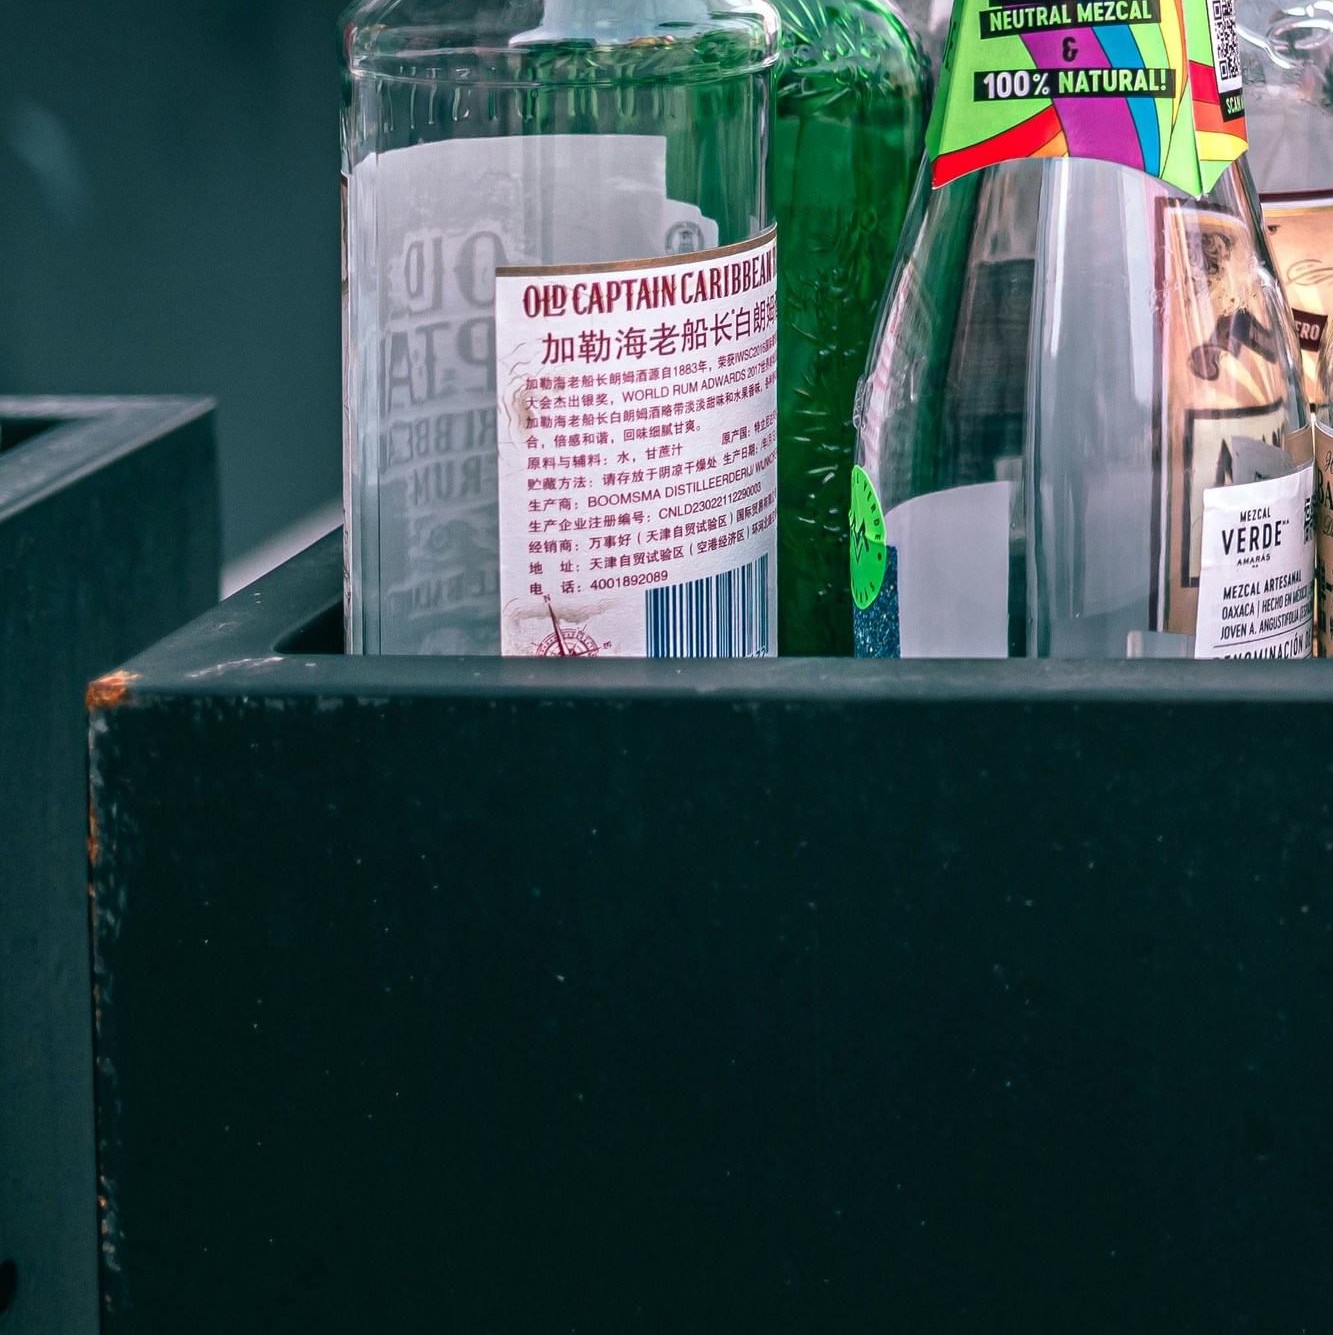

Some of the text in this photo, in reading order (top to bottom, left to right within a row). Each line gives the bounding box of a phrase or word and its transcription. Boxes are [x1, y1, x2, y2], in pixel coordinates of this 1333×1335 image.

[990, 0, 1152, 32] NEUTRAL MEZCAL
[1062, 36, 1078, 62] &
[983, 69, 1167, 99] 100% NATURAL!
[523, 252, 773, 319] OLD CAPTAIN CARIBBEAN
[622, 384, 670, 403] WORLD
[672, 379, 699, 396] RUM
[701, 370, 746, 392] ADWARDS
[588, 489, 661, 509] BOOMSMA
[1239, 506, 1271, 523] MEZCAL
[1221, 521, 1282, 556] VERDE
[1236, 553, 1271, 566] AMARÁS
[590, 570, 669, 591] 4001892089
[1223, 568, 1302, 601] MEZCAL ARTESANAL
[1221, 600, 1255, 621] OAXACA
[1262, 595, 1284, 613] HECHO
[1285, 593, 1292, 608] EN
[1220, 611, 1299, 641] JOVEN A. ANGUSTIFOLIA
